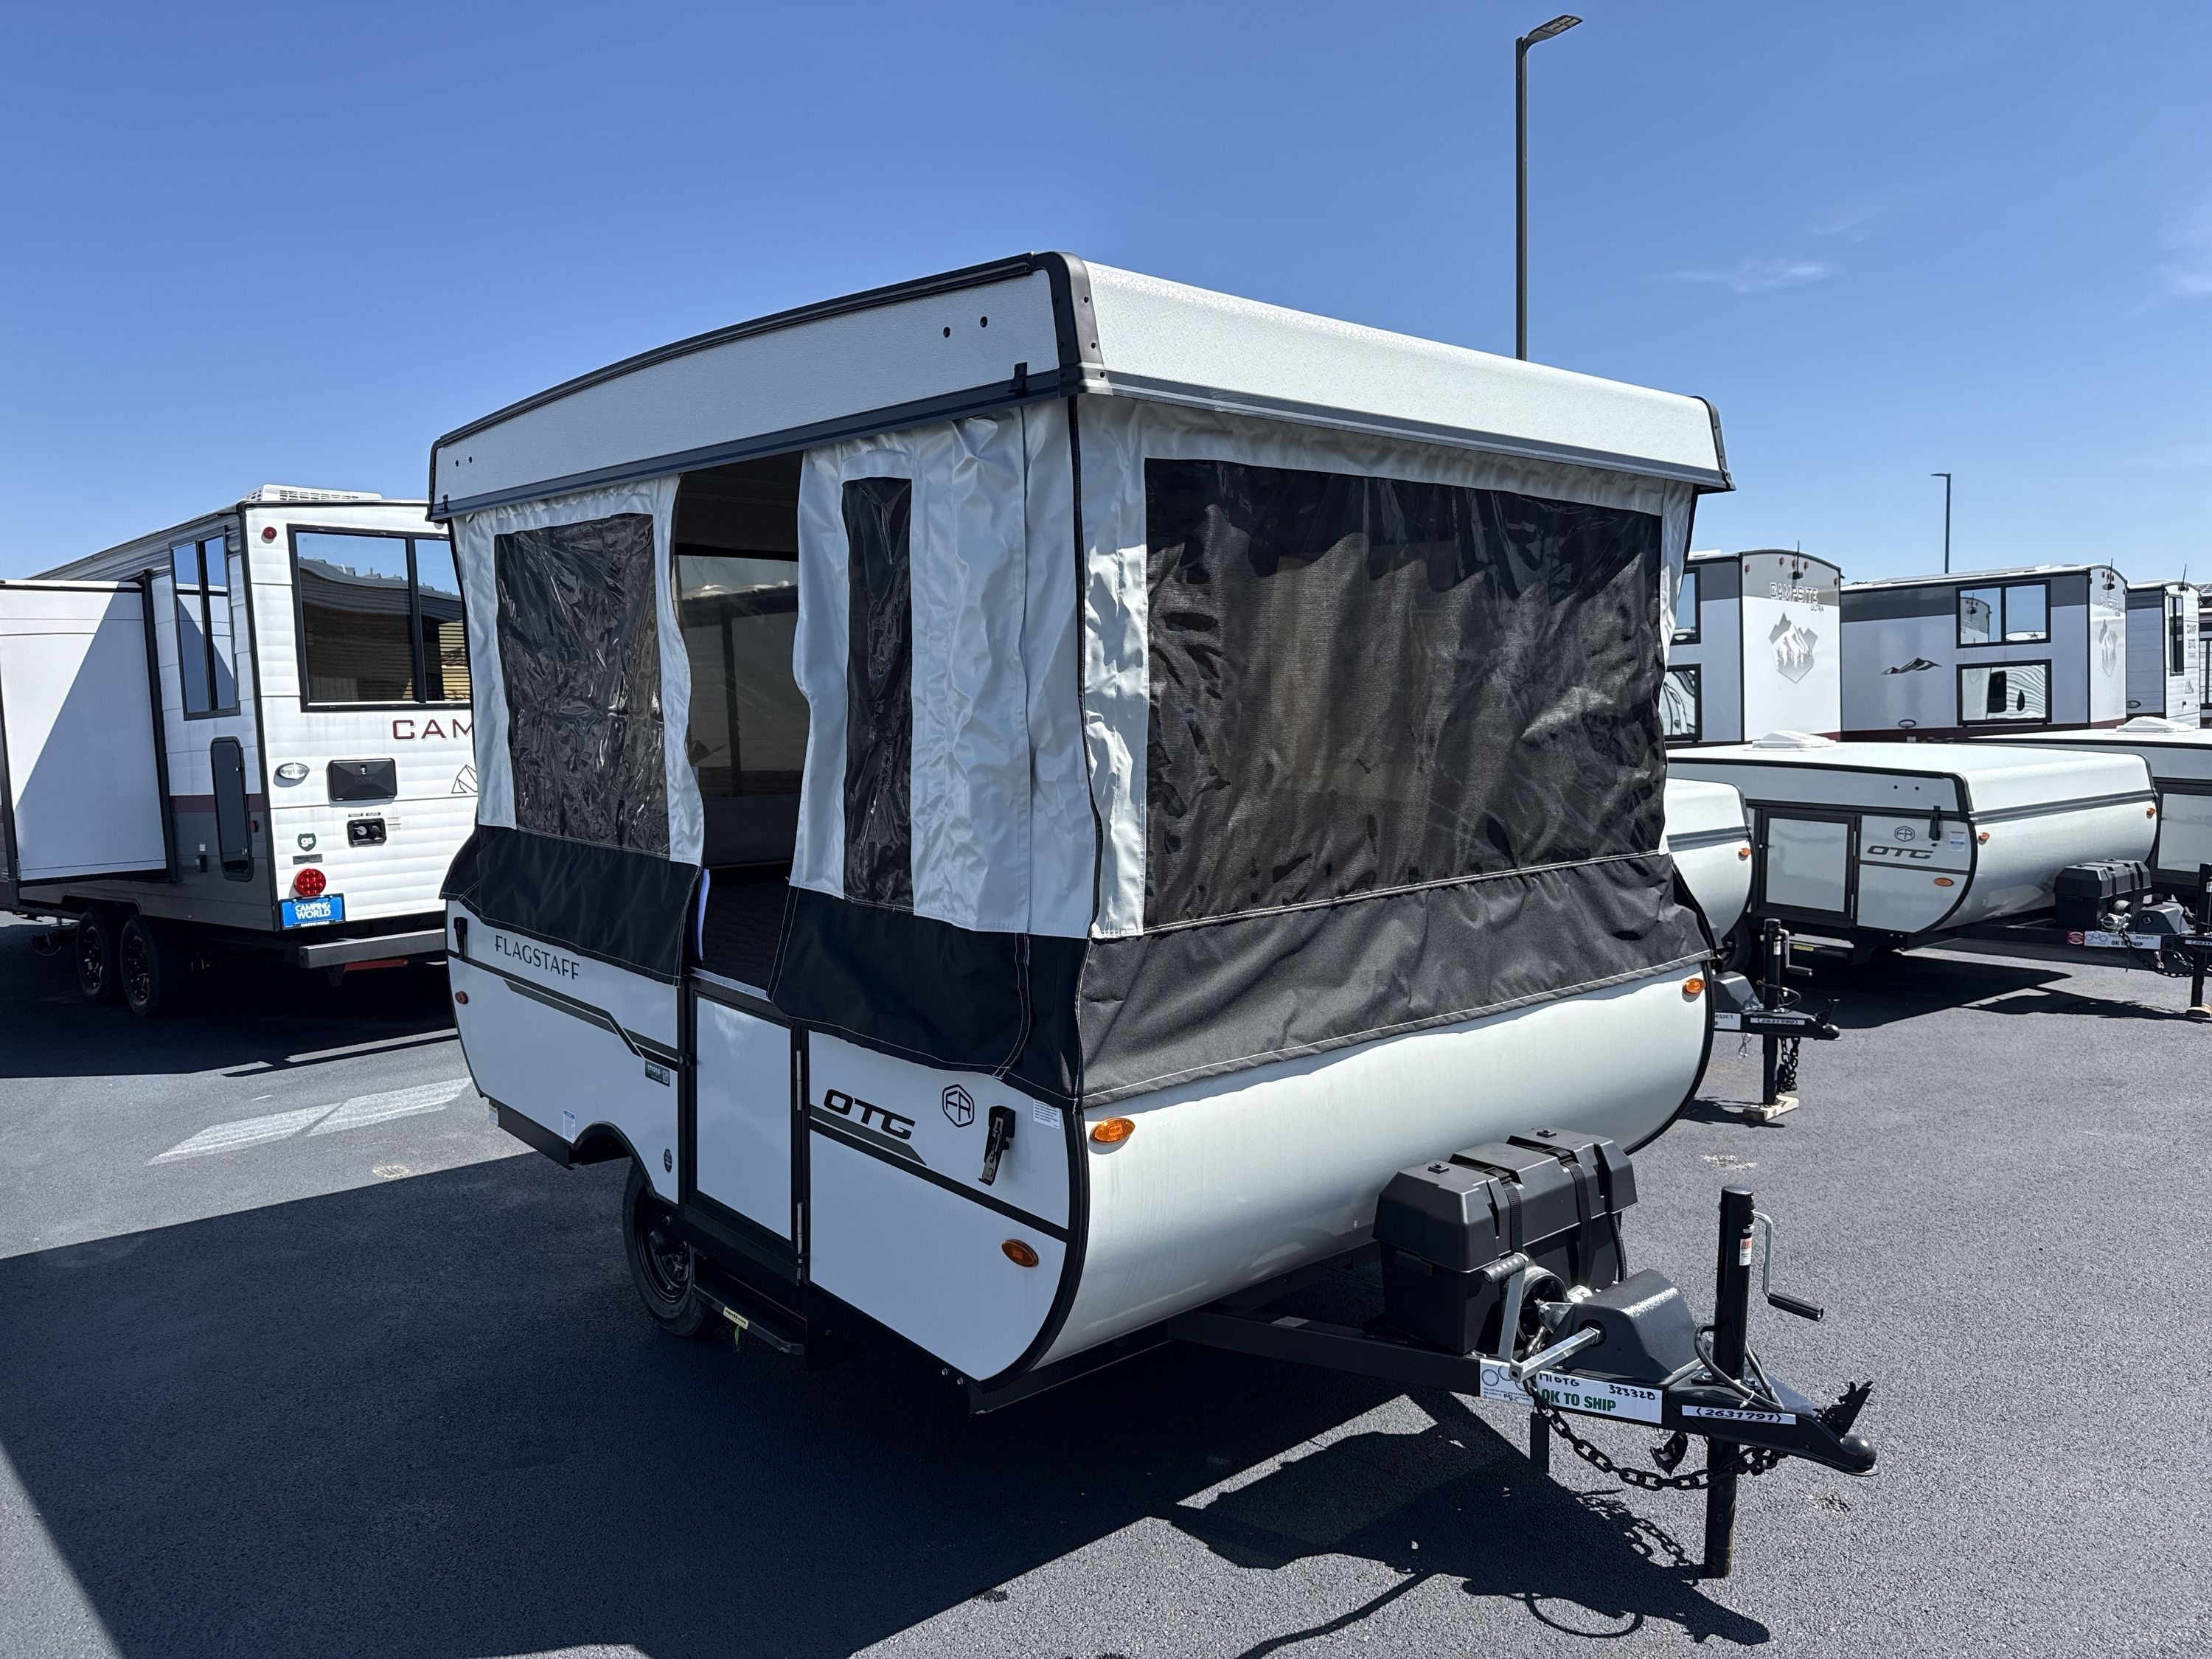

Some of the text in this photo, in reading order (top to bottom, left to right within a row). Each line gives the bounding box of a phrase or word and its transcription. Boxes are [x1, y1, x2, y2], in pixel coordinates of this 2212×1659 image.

[1770, 582, 1818, 604] CAMPSITE
[1867, 845, 1933, 860] OTG
[295, 902, 331, 912] CAMPING
[296, 908, 332, 920] WORLD
[495, 934, 580, 980] FLAGSTAFF
[823, 1088, 916, 1140] OTG
[1541, 1388, 1560, 1403] OK
[1563, 1392, 1580, 1407] TO
[1583, 1395, 1616, 1412] SHIP
